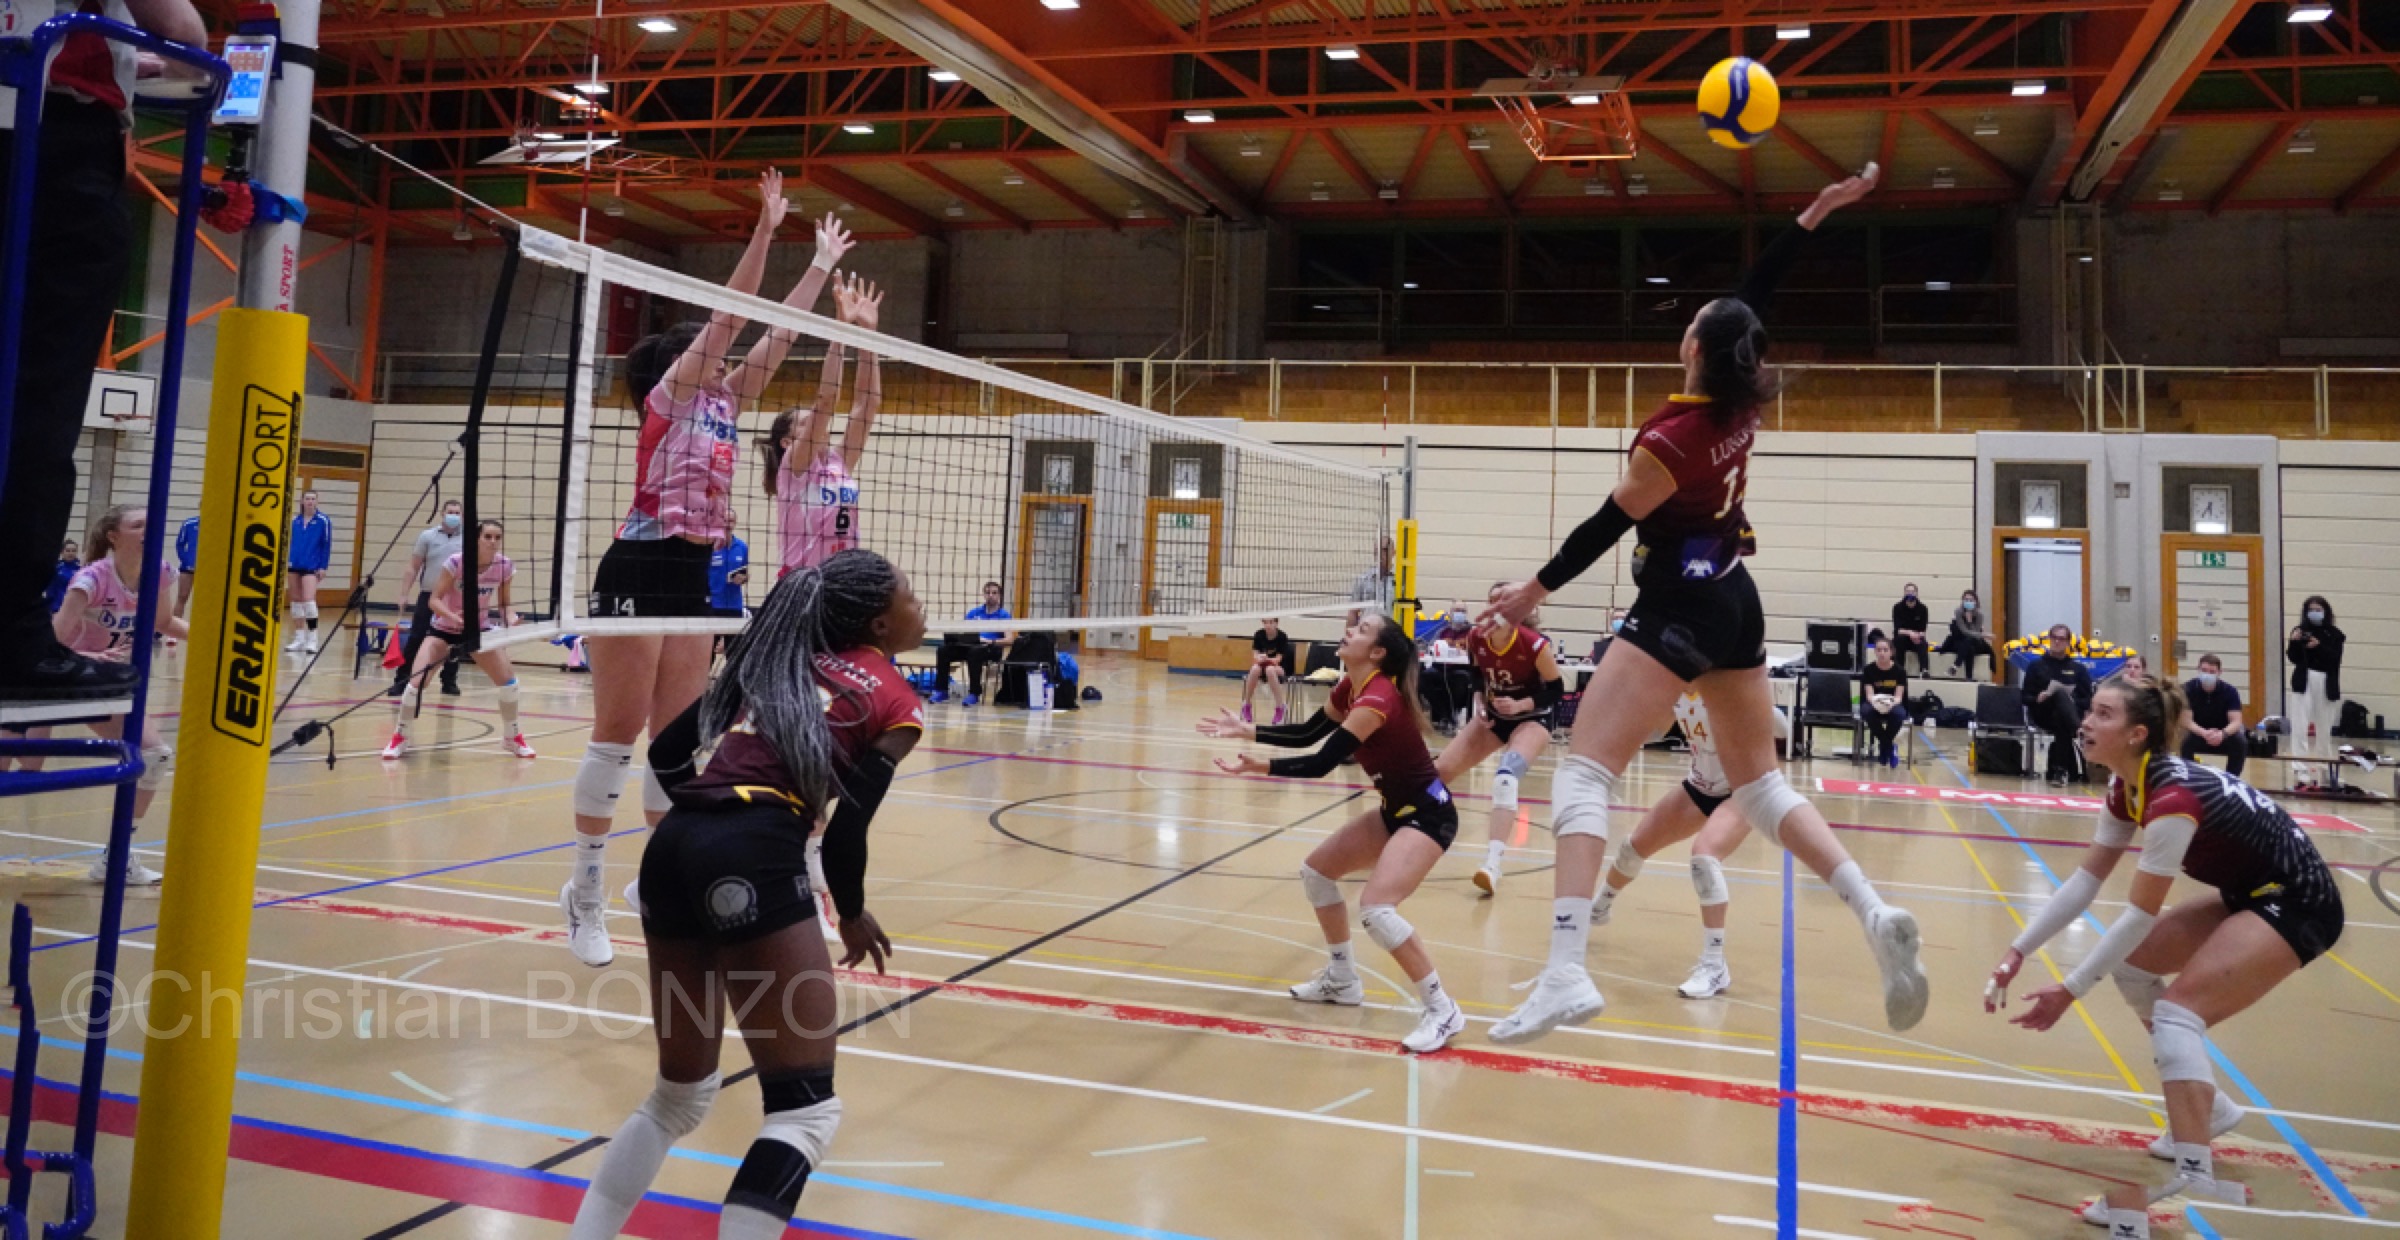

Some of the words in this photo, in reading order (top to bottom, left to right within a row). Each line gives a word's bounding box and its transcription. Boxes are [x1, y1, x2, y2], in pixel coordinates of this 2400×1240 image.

[247, 402, 288, 511] SPORT
[835, 506, 851, 530] 6
[225, 522, 276, 729] ERHARD
